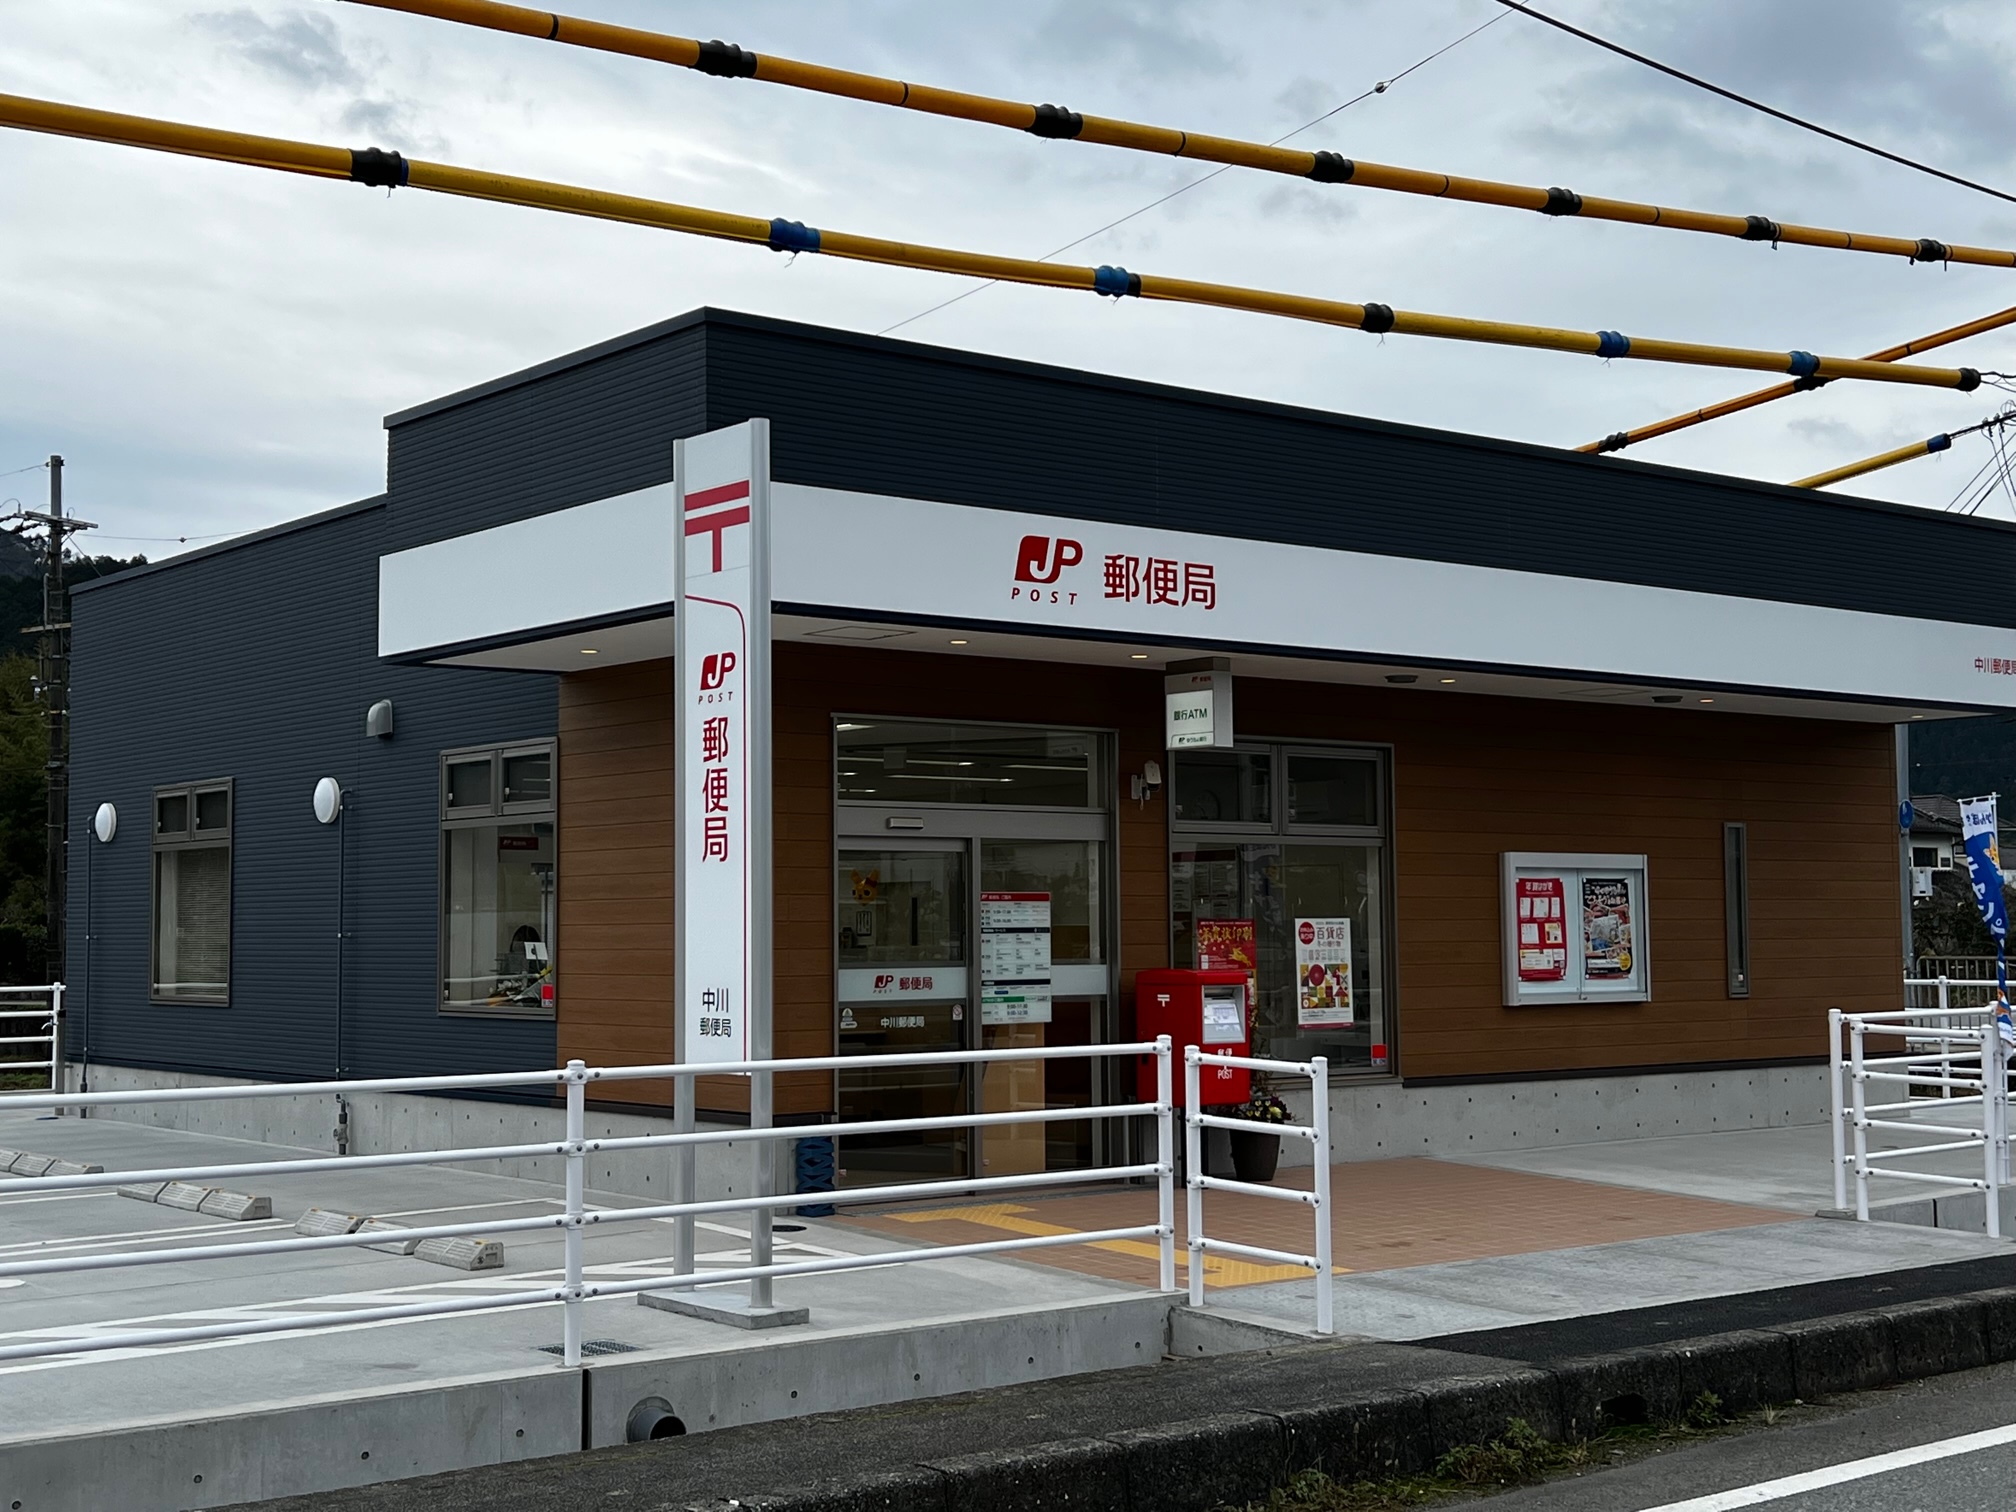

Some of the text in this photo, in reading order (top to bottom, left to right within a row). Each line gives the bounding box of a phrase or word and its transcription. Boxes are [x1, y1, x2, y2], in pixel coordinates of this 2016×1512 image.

[1103, 554, 1216, 610] 郵便局
[1011, 586, 1078, 606] POST
[698, 691, 734, 705] POST
[702, 716, 729, 863] 郵便局
[899, 976, 934, 991] 郵便局
[702, 987, 729, 1013] 中川
[699, 1017, 732, 1038] 郵便局
[880, 1015, 925, 1029] 中川郵便局
[1217, 1069, 1233, 1080] POST
